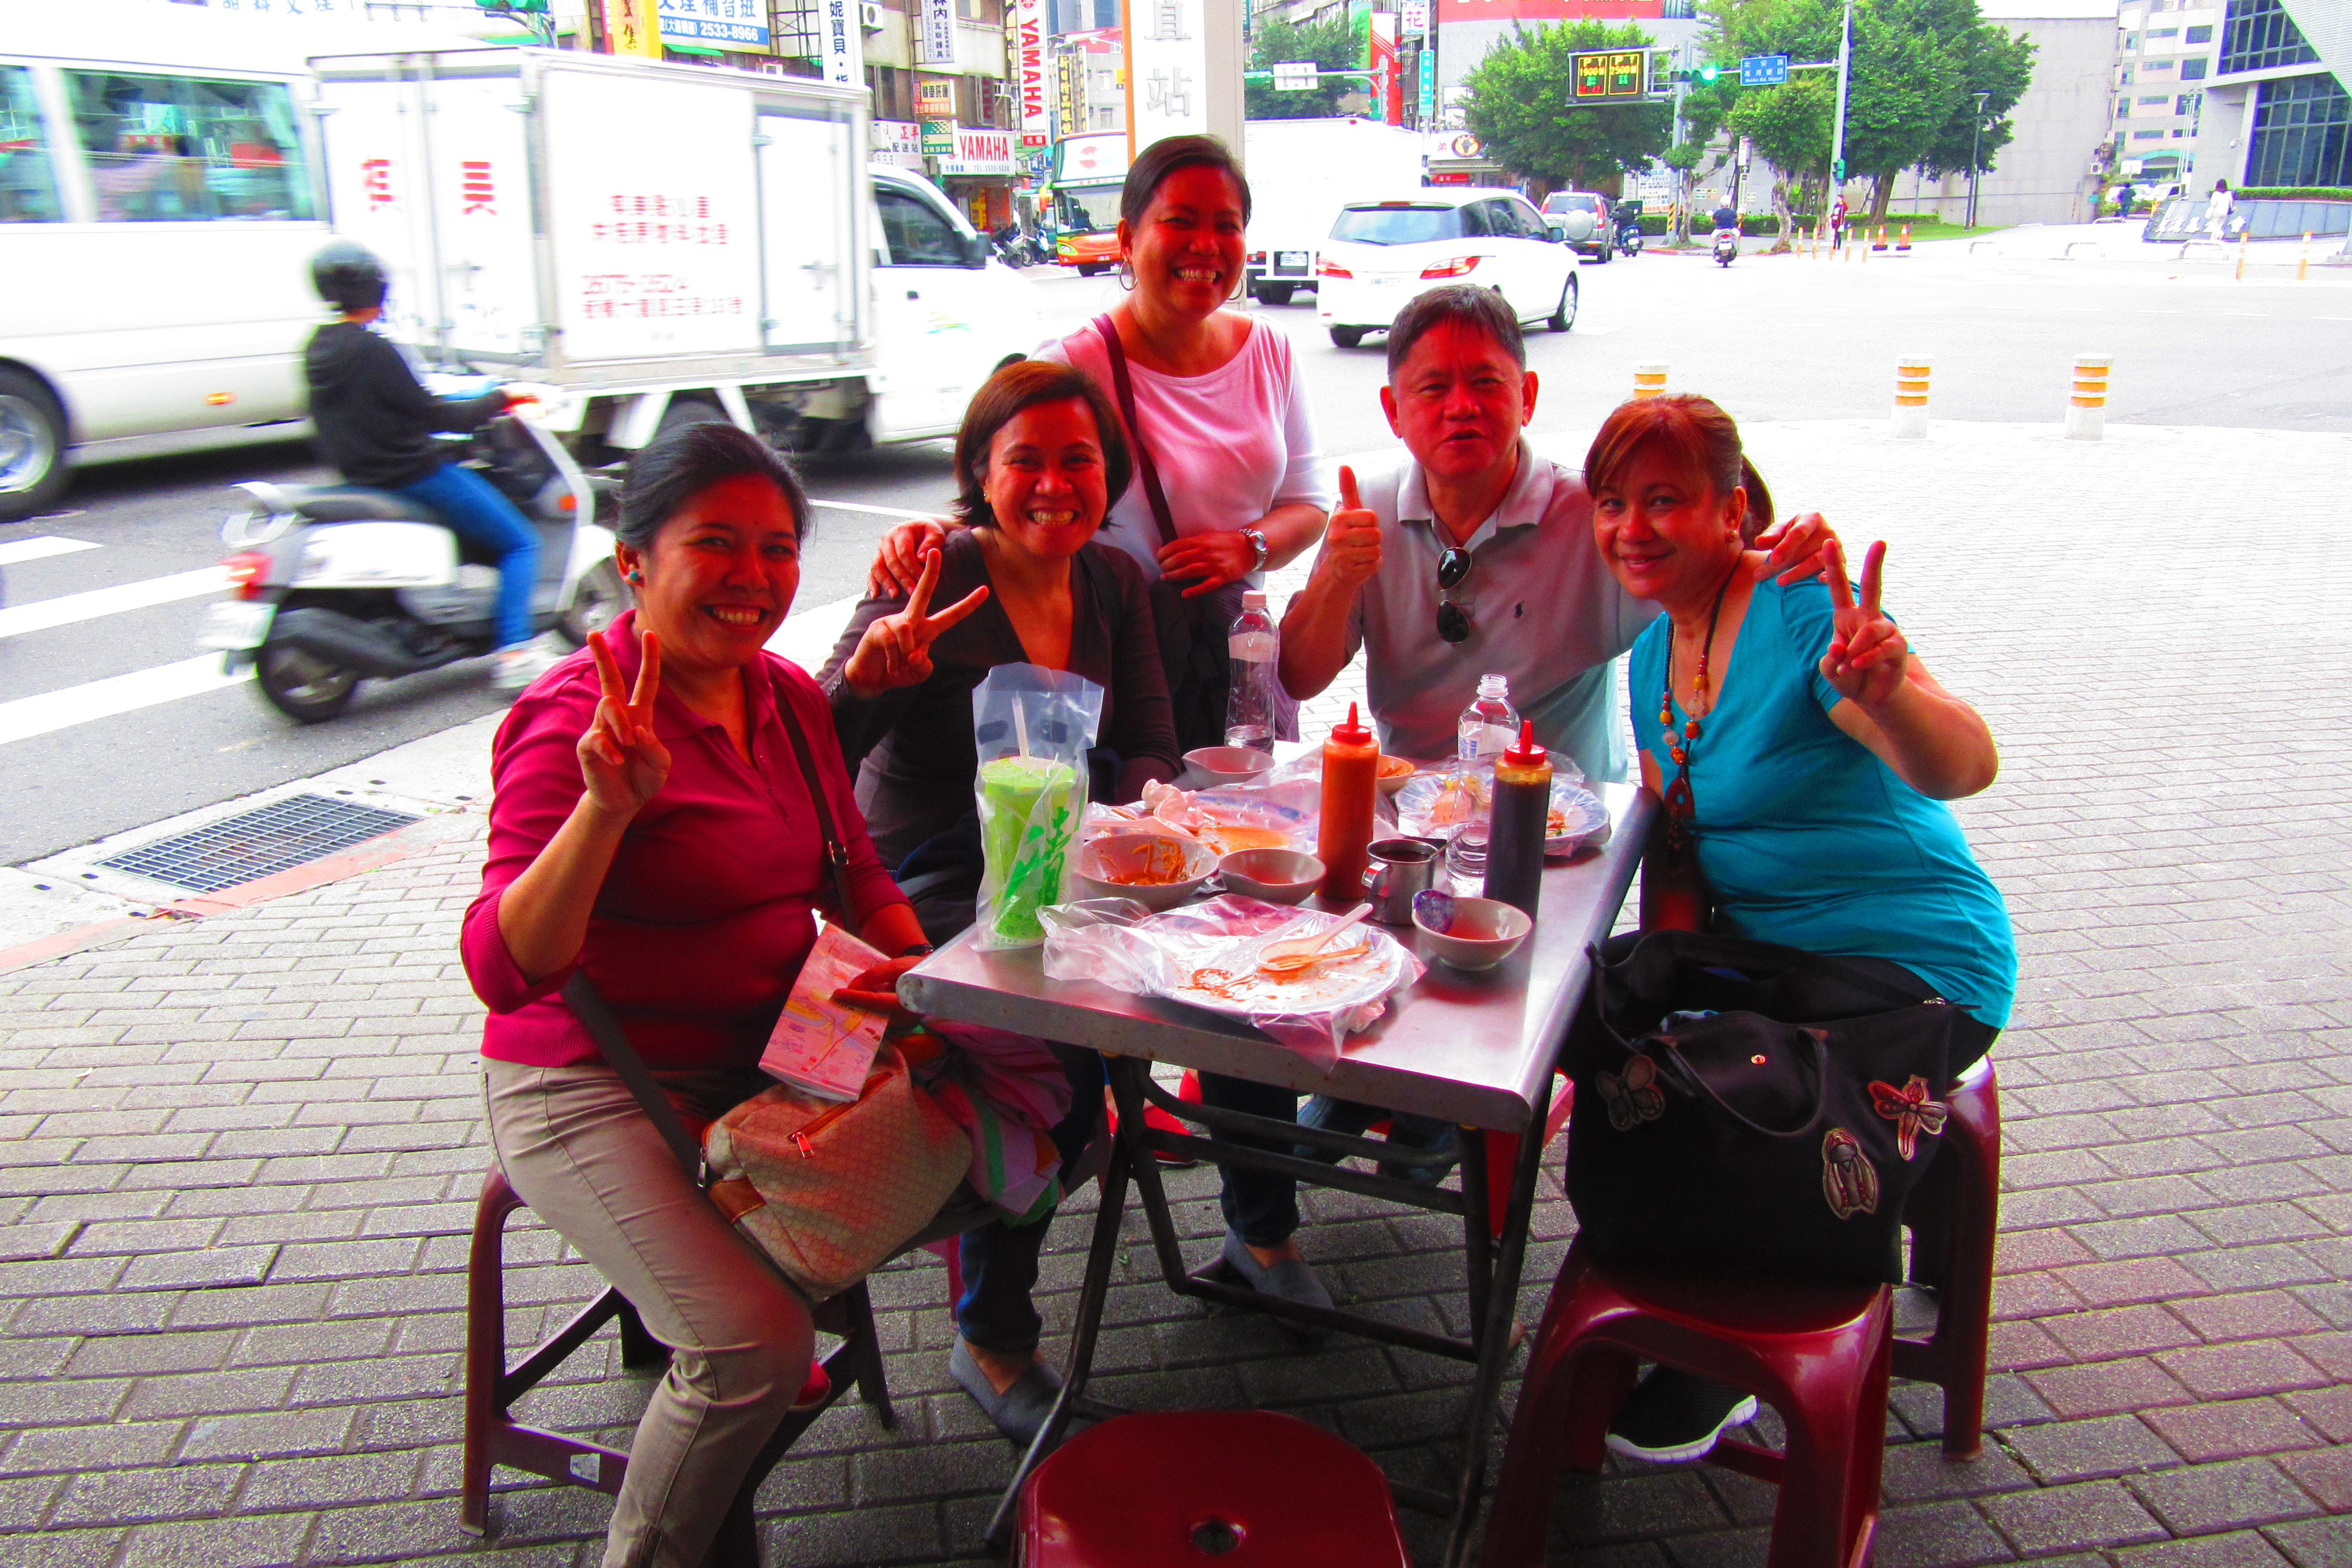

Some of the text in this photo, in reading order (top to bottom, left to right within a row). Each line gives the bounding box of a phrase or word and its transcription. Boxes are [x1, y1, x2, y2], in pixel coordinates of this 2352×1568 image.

[1406, 10, 1424, 28] 花
[700, 22, 759, 42] 2533-8966
[1020, 17, 1042, 119] YAMAHA
[1583, 57, 1591, 67] P
[1614, 56, 1624, 65] P
[959, 135, 1010, 161] YAMAHA
